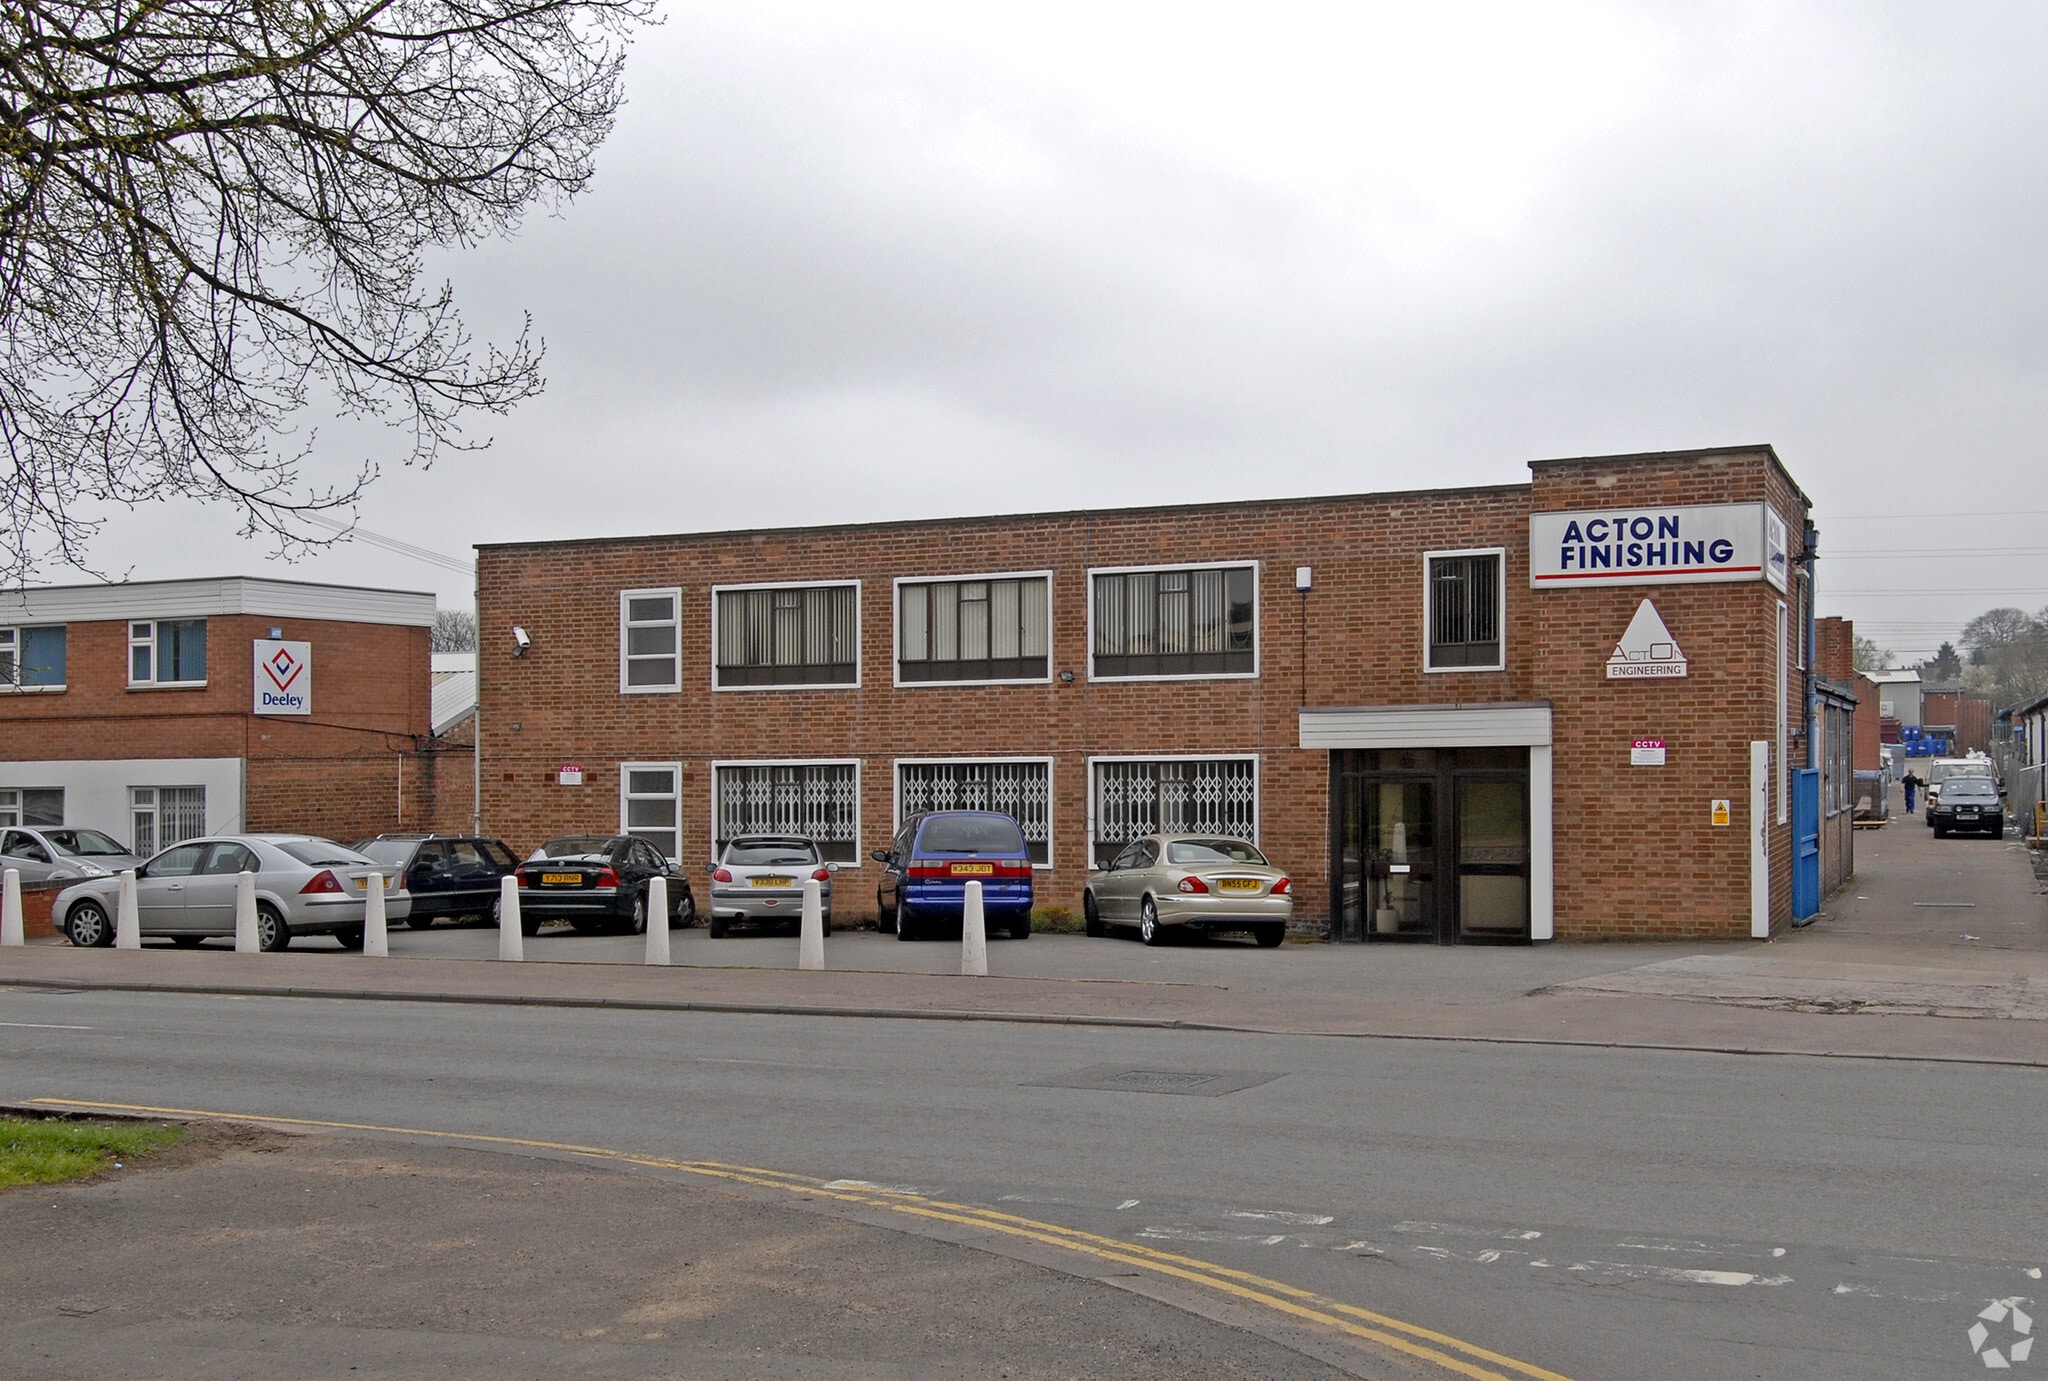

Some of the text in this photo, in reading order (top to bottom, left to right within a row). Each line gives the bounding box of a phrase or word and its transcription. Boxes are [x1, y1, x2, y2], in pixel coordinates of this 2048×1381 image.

[1561, 515, 1680, 544] ACTON
[1560, 538, 1734, 570] FINISHING
[1612, 664, 1682, 676] ENGINEERING
[262, 692, 304, 710] Deeley
[1635, 740, 1661, 748] CCTV
[975, 864, 992, 873] JDT
[1222, 879, 1241, 888] BN55
